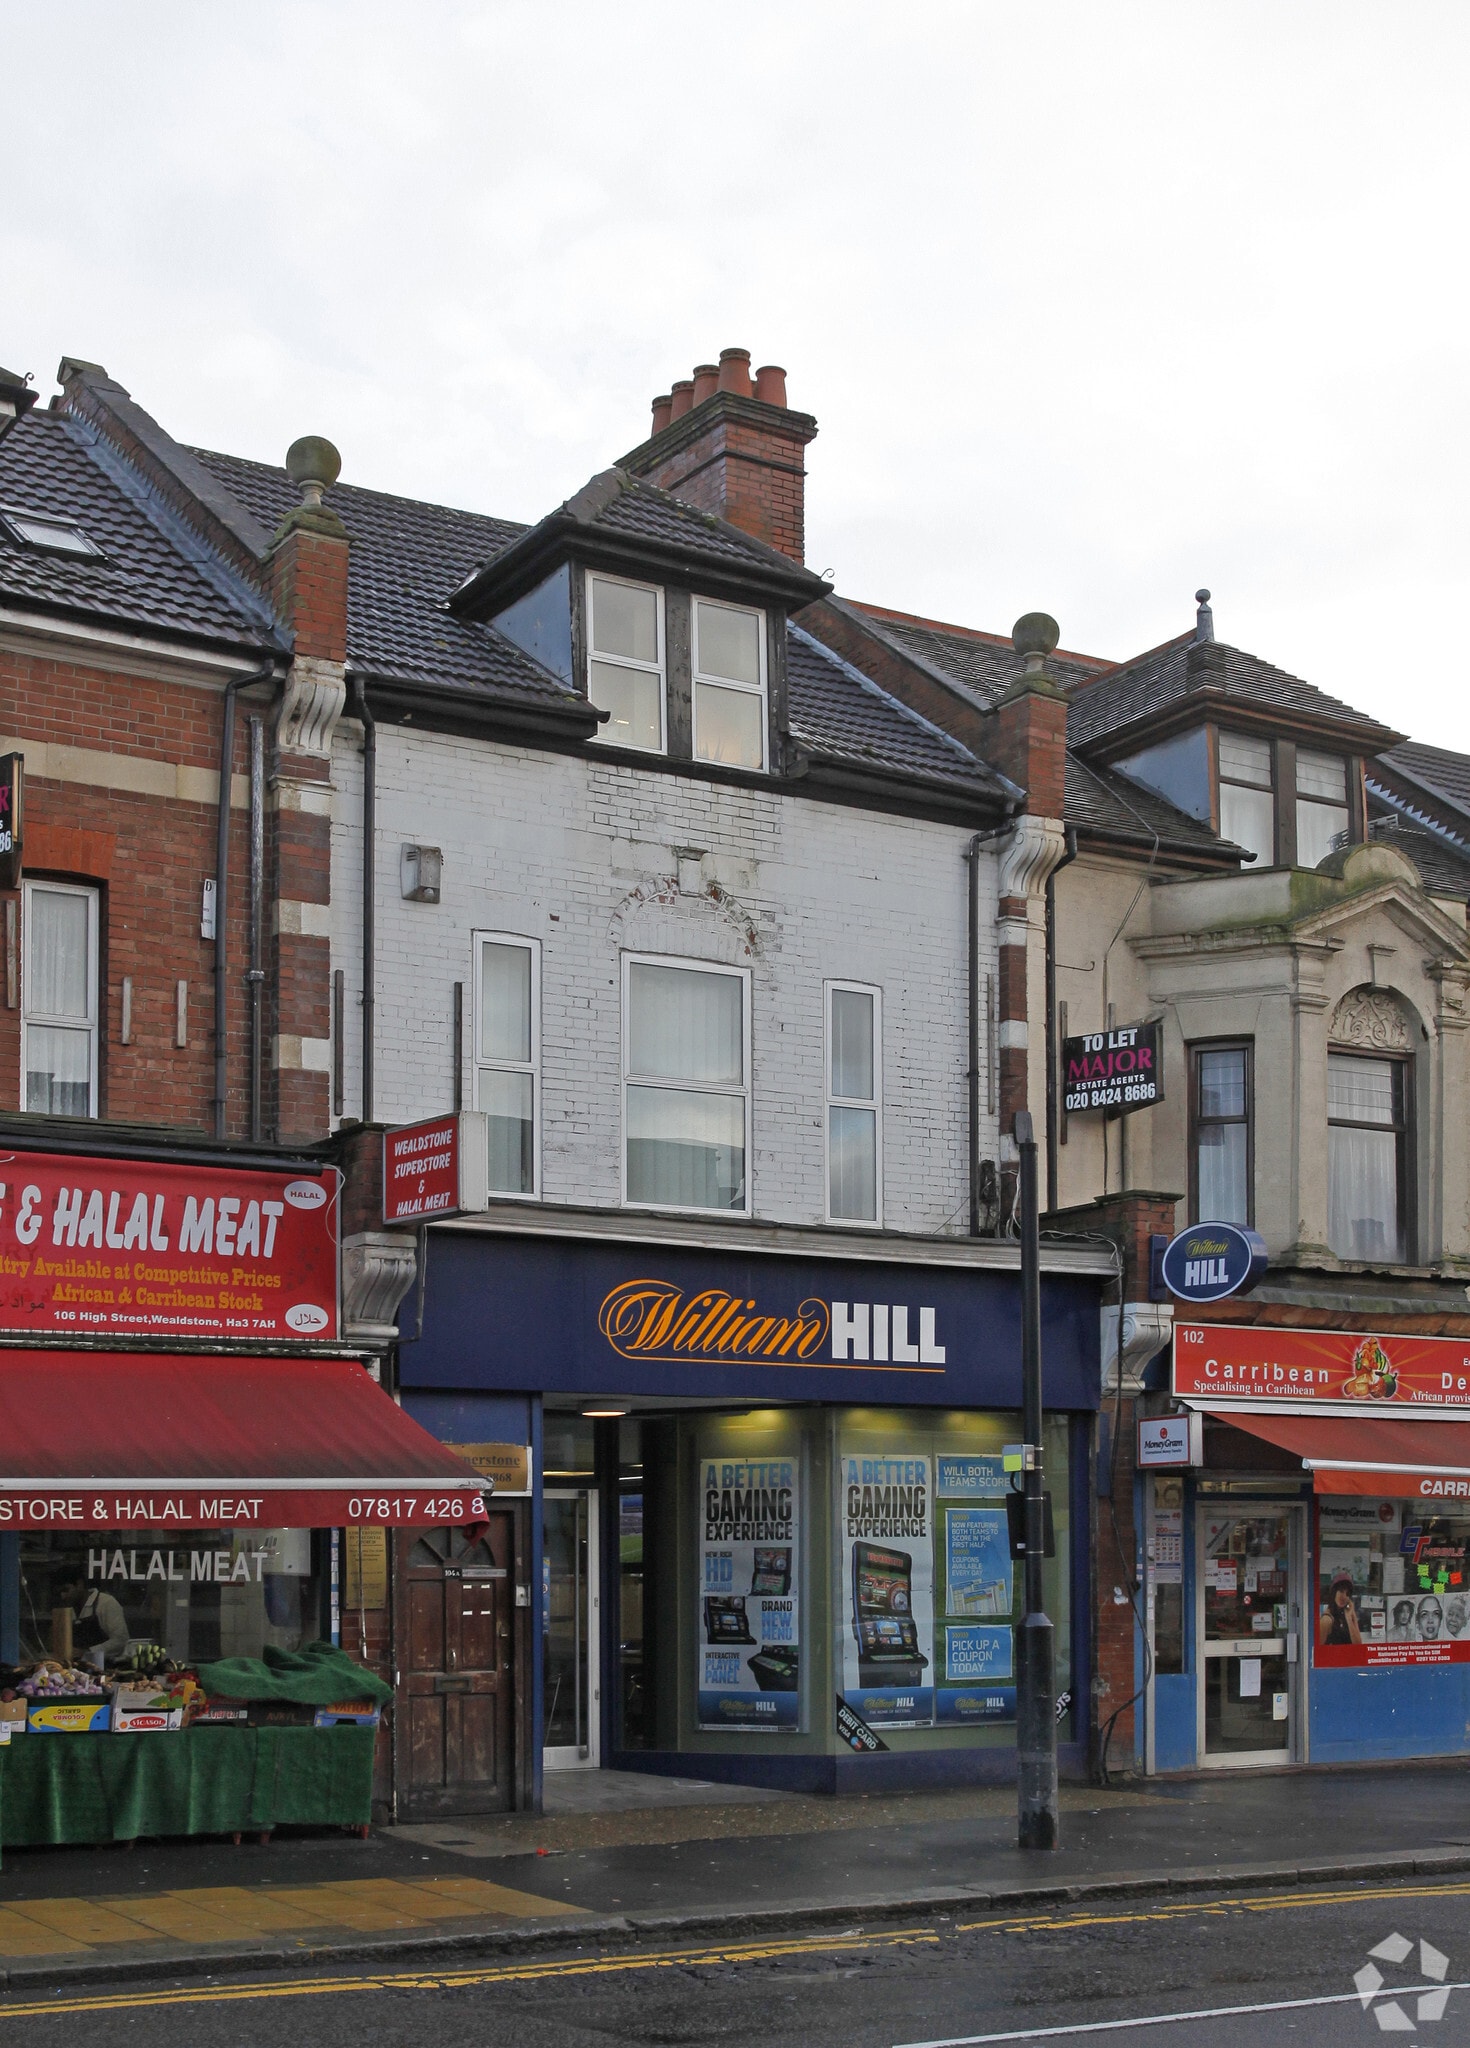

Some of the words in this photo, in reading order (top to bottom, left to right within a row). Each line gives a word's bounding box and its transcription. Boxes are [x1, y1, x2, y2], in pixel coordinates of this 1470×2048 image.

[1083, 1034, 1104, 1052] TO
[1108, 1029, 1138, 1049] LET
[1069, 1047, 1152, 1081] MAJOR
[1076, 1080, 1107, 1091] ESTATE
[1111, 1074, 1145, 1086] AGENTS
[1066, 1092, 1088, 1110] 020
[1091, 1087, 1121, 1106] 8424
[1125, 1082, 1156, 1102] 8686
[394, 1128, 453, 1157] WEALDSTONE
[394, 1152, 451, 1179] SUPERSTORE
[290, 1190, 321, 1200] HALAL
[418, 1179, 425, 1194] &
[396, 1198, 422, 1216] HALAL
[424, 1192, 451, 1210] MEAT
[15, 1184, 43, 1245] &
[52, 1187, 169, 1251] HALAL
[178, 1195, 285, 1259] MEAT
[1186, 1238, 1230, 1258] William
[33, 1256, 112, 1280] Available
[114, 1262, 131, 1280] at
[133, 1262, 229, 1286] Competitive
[231, 1268, 282, 1289] Prices
[1184, 1258, 1229, 1287] HILL
[52, 1283, 115, 1304] African
[118, 1286, 133, 1304] &
[135, 1287, 216, 1309] Carribean
[218, 1291, 264, 1311] Stock
[54, 1311, 76, 1320] 106
[79, 1311, 108, 1323] High
[226, 1318, 249, 1328] Ha3
[253, 1319, 276, 1329] 7AH
[294, 1312, 322, 1326] حلال
[598, 1278, 830, 1360] William
[831, 1301, 946, 1364] HILL
[1182, 1330, 1205, 1344] 102
[1205, 1359, 1329, 1383] Carribean
[1193, 1379, 1252, 1396] Specialising
[1254, 1383, 1263, 1394] in
[1266, 1383, 1315, 1396] Caribbean
[1411, 1391, 1443, 1402] African
[705, 1464, 718, 1489] A
[721, 1462, 793, 1489] BETTER
[847, 1460, 858, 1484] A
[862, 1460, 926, 1485] BETTER
[943, 1466, 966, 1476] WILL
[968, 1466, 993, 1477] BOTH
[943, 1477, 976, 1487] TEAMS
[0, 1499, 84, 1520] STORE
[92, 1499, 109, 1520] &
[115, 1500, 192, 1519] HALAL
[200, 1499, 264, 1519] MEAT
[348, 1498, 417, 1518] 07817
[423, 1498, 464, 1518] 426
[706, 1488, 792, 1522] GAMING
[847, 1485, 926, 1519] GAMING
[705, 1521, 793, 1541] EXPERIENCE
[847, 1518, 927, 1538] EXPERIENCE
[88, 1549, 184, 1580] HALAL
[190, 1551, 268, 1582] MEAT
[705, 1558, 733, 1582] HD
[761, 1600, 793, 1612] BRAND
[761, 1612, 792, 1627] NEW
[761, 1627, 793, 1640] MENU
[952, 1640, 974, 1651] PICK
[975, 1640, 990, 1650] UP
[992, 1639, 1000, 1649] A
[705, 1659, 740, 1670] PLAYER
[952, 1651, 993, 1662] COUPON
[705, 1669, 740, 1684] PANEL
[952, 1662, 986, 1673] TODAY.
[756, 1702, 777, 1711] HILL
[896, 1697, 914, 1707] HILL
[986, 1697, 1005, 1707] HILL
[838, 1710, 857, 1731] DEBIT
[856, 1724, 877, 1750] CARD
